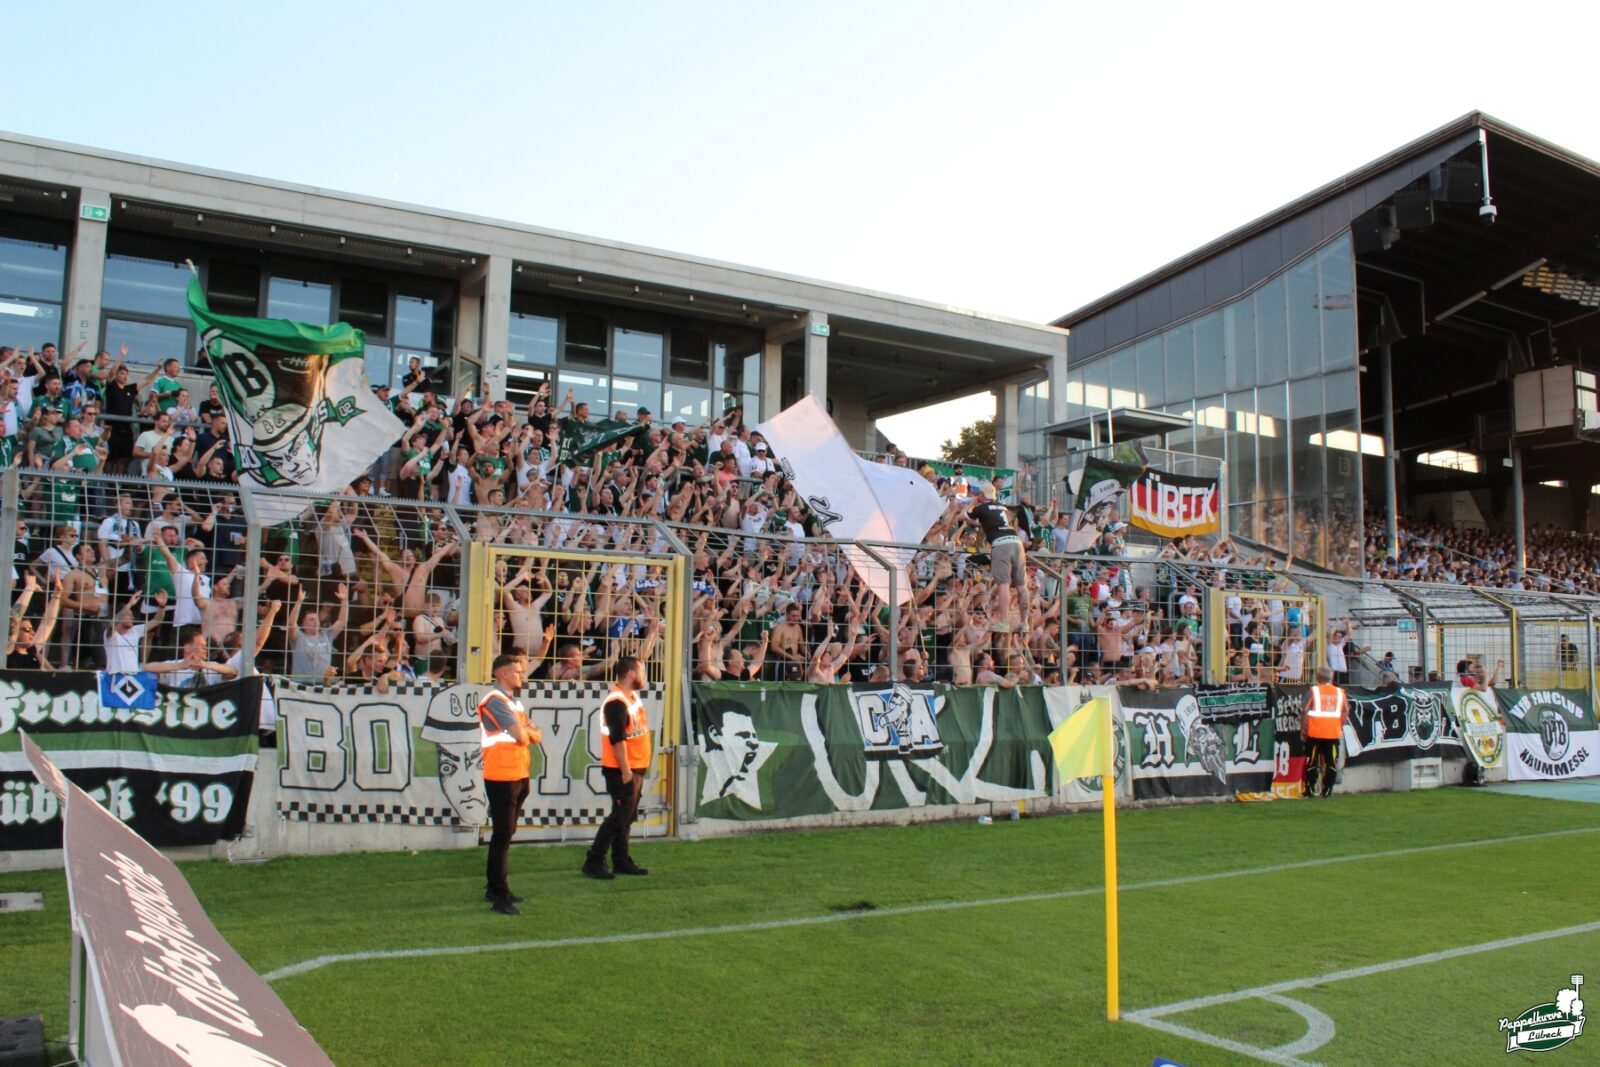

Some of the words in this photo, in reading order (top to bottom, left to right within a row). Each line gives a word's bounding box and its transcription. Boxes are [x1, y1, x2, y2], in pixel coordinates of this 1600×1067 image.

[1132, 473, 1216, 528] LÜBECK
[1530, 691, 1584, 719] FANCLUB
[1519, 746, 1590, 776] KRUMMESSE
